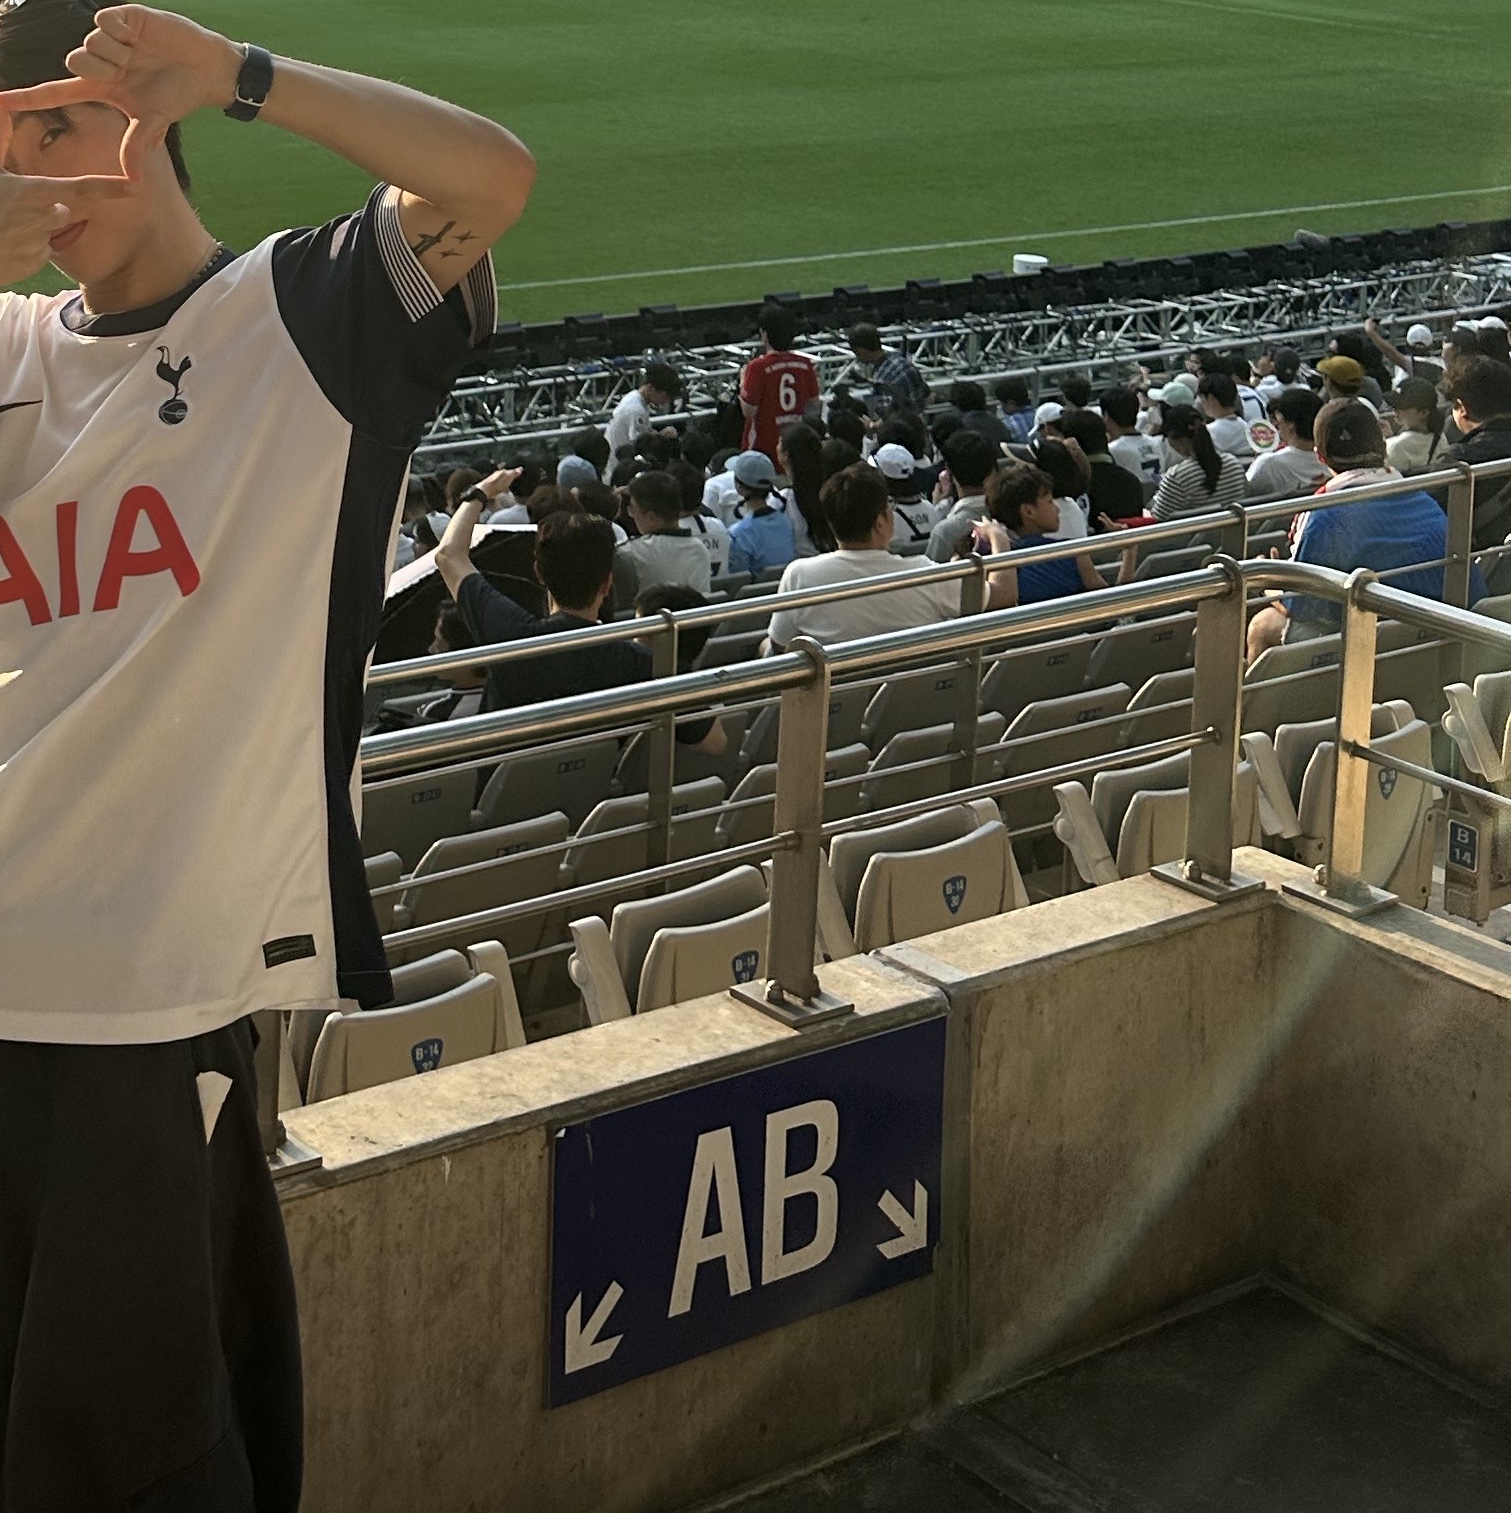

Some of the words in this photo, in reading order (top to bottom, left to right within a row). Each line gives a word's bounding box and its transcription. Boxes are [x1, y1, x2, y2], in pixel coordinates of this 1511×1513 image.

[779, 374, 796, 412] 6
[1457, 828, 1469, 843] B
[1454, 848, 1472, 864] 14
[945, 879, 964, 895] B-14
[735, 955, 756, 972] B-14
[415, 1043, 439, 1061] B-14
[668, 1099, 839, 1318] AB
